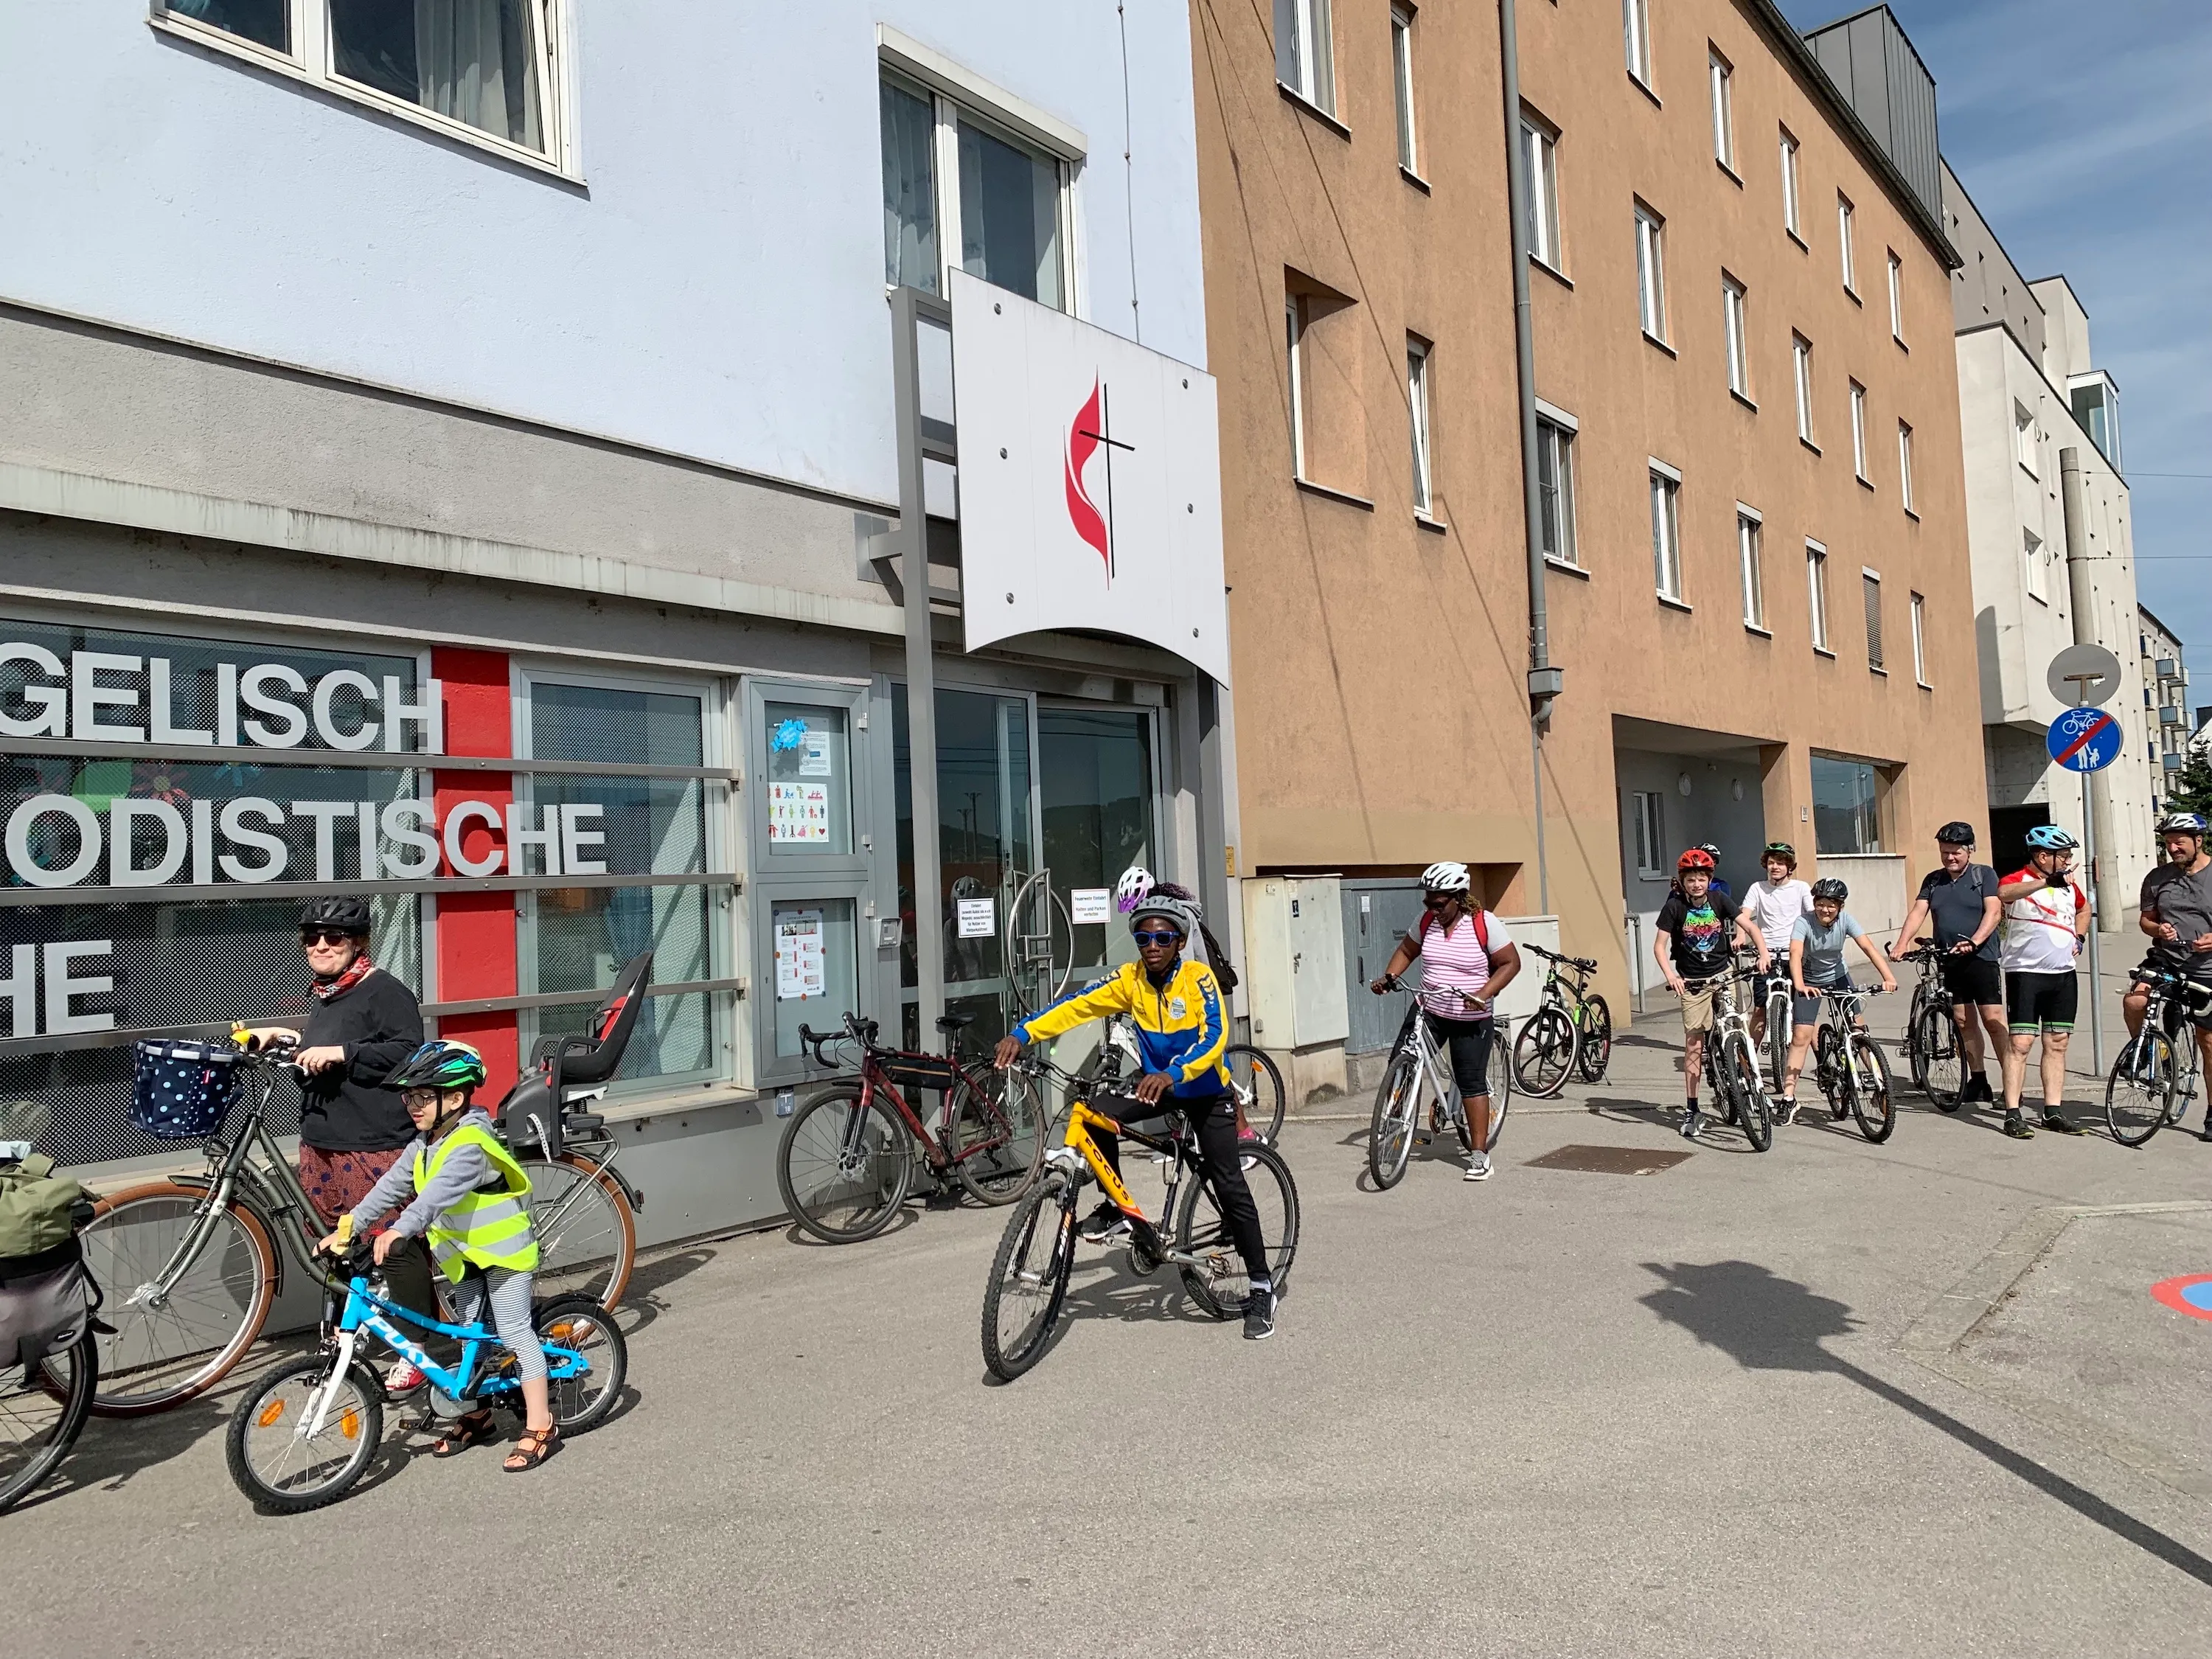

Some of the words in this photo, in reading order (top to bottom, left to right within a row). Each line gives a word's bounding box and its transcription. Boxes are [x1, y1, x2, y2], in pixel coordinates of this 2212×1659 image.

[0, 642, 444, 754] GELISCH
[4, 793, 608, 887] ODISTISCHE
[1085, 1136, 1130, 1201] FOCUS
[364, 1315, 444, 1371] PUKY
